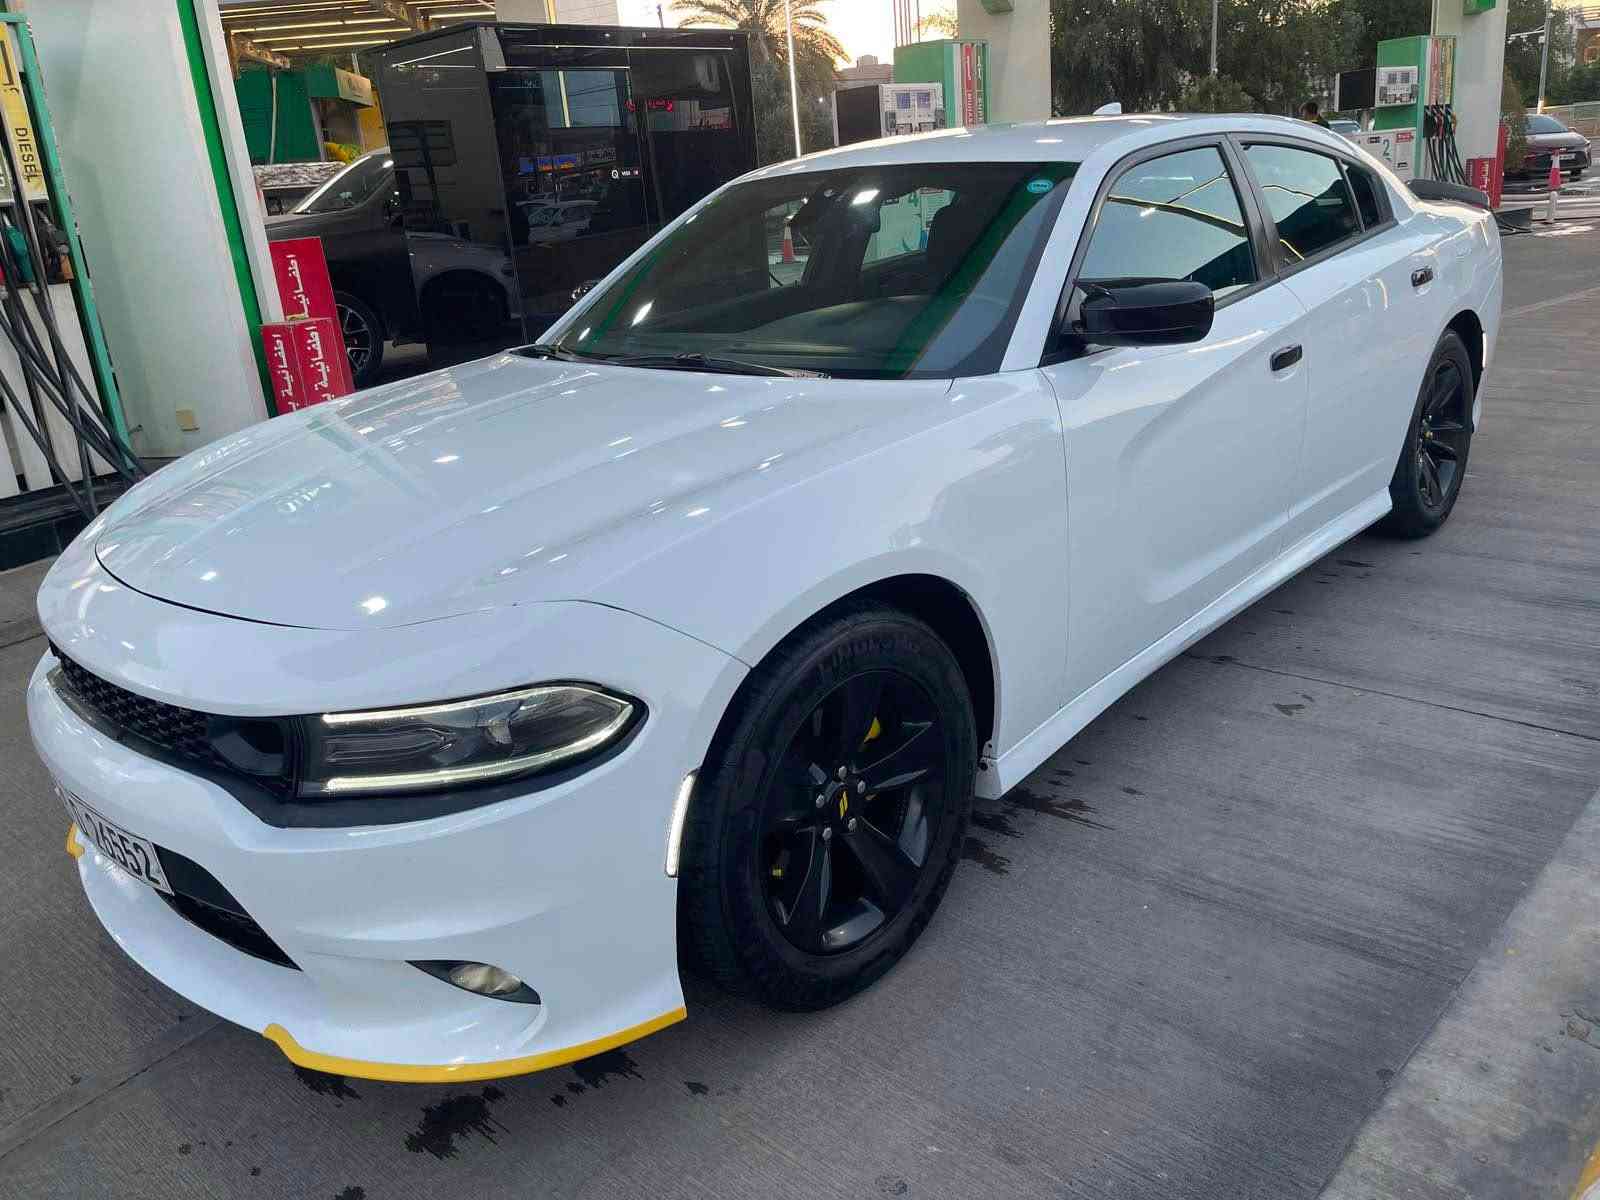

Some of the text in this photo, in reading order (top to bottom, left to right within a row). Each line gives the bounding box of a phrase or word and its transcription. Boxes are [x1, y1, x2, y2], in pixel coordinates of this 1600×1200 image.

[15, 127, 39, 183] DIESEL
[1382, 138, 1391, 157] 2
[85, 812, 161, 885] 26552
